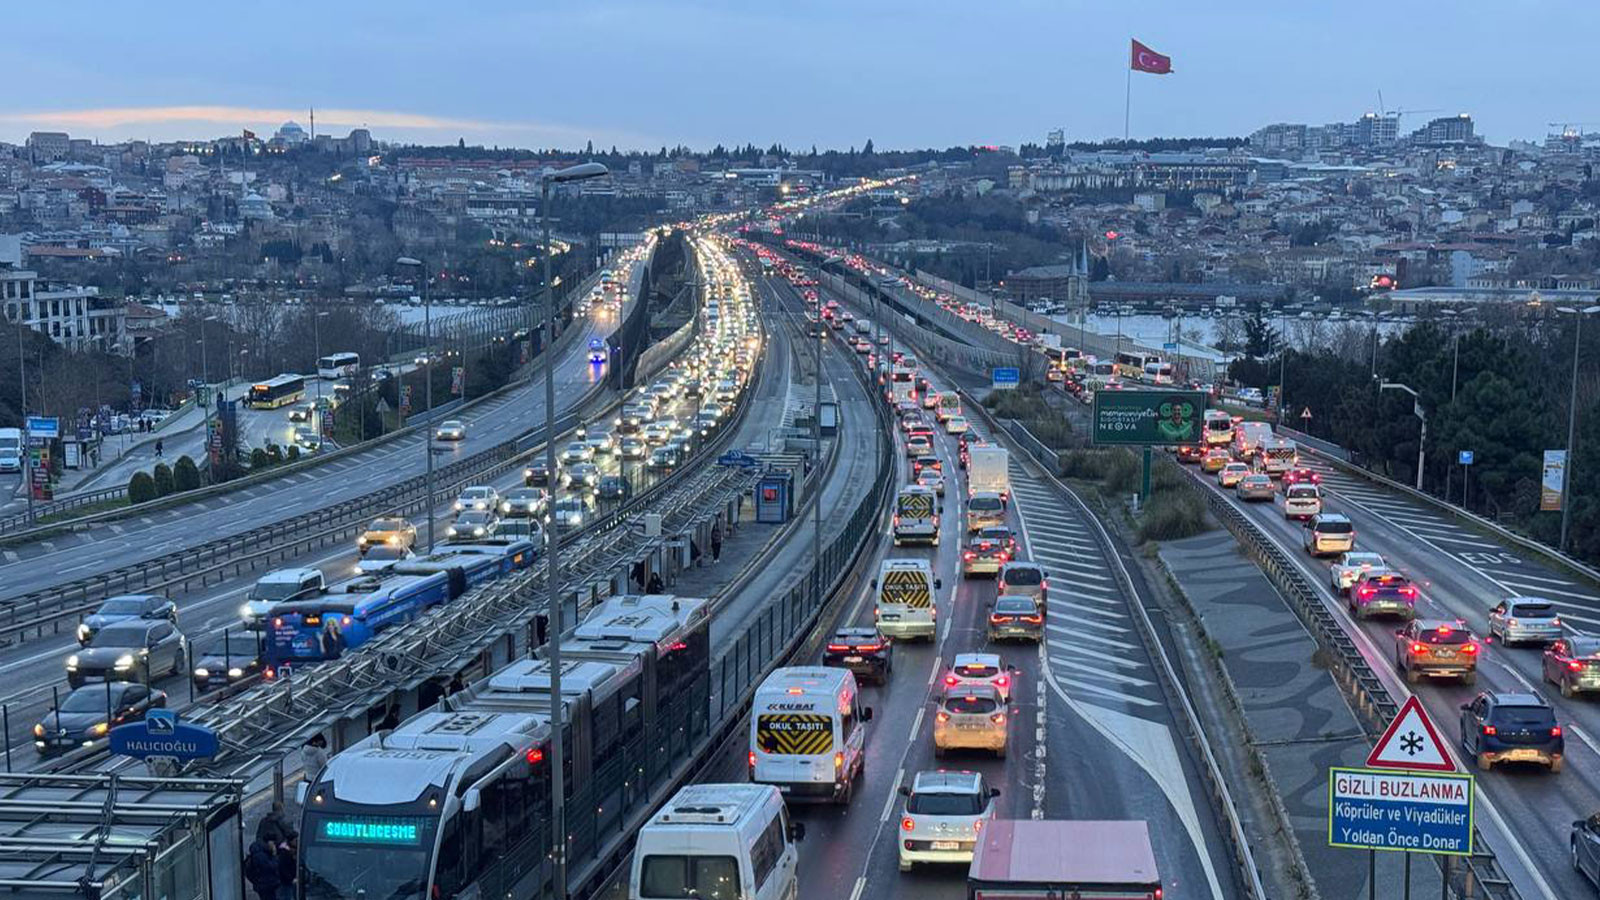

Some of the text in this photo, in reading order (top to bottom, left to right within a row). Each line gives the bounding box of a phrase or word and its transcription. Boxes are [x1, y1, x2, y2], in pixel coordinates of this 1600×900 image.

[1099, 422, 1137, 431] NEOVA
[1458, 552, 1522, 564] EDS
[769, 722, 824, 732] OKUL TAŞITI
[126, 740, 197, 753] HALICIOĞLU
[1337, 775, 1465, 800] GİZLİ BUZLANMA
[1335, 802, 1466, 827] Köprüler ve Viyadükler
[1342, 827, 1462, 850] Yoldan Önce Donar
